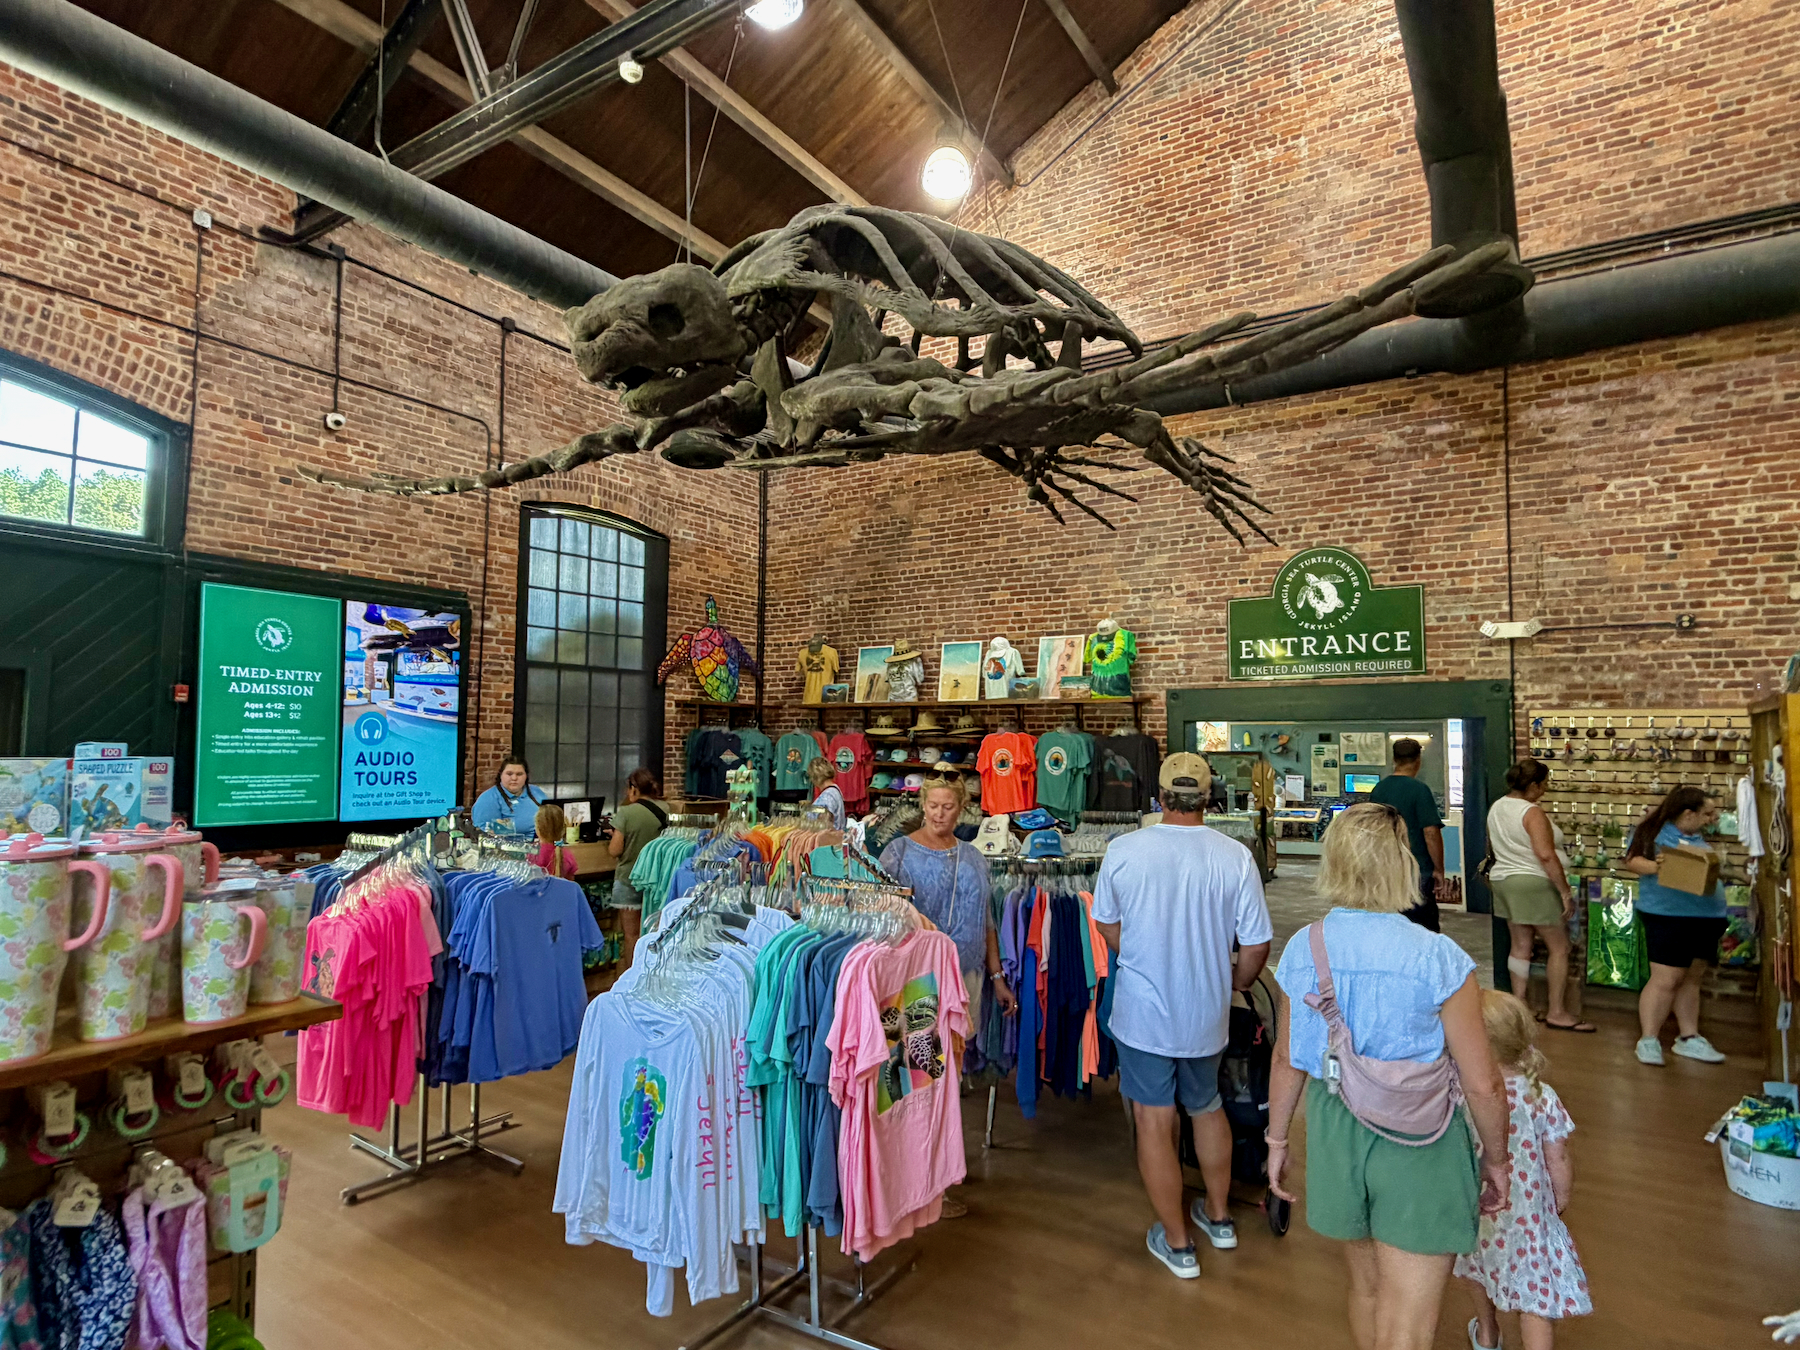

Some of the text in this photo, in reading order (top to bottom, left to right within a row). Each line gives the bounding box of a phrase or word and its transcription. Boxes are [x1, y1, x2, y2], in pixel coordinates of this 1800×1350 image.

[1281, 556, 1360, 620] GEORGIA SEA TURTLE CENTER
[1298, 591, 1362, 631] JEKYLL ISLAND
[1239, 630, 1412, 659] ENTRANCE
[219, 665, 323, 683] TIMED-ENTRY
[1240, 659, 1412, 676] TICKETED ADMISSION REQUIRED
[228, 681, 314, 697] ADMISSION
[244, 701, 264, 710] Ages
[265, 702, 286, 710] 4-12:
[243, 711, 264, 719] Ages
[265, 711, 281, 719] 13+:
[354, 751, 415, 766] AUDIO
[78, 763, 133, 775] SHAPED PUZZLE
[354, 770, 418, 786] TOURS
[352, 792, 375, 800] Inquire
[408, 790, 424, 798] Shop
[352, 800, 371, 808] check
[695, 1095, 717, 1190] Jekyll
